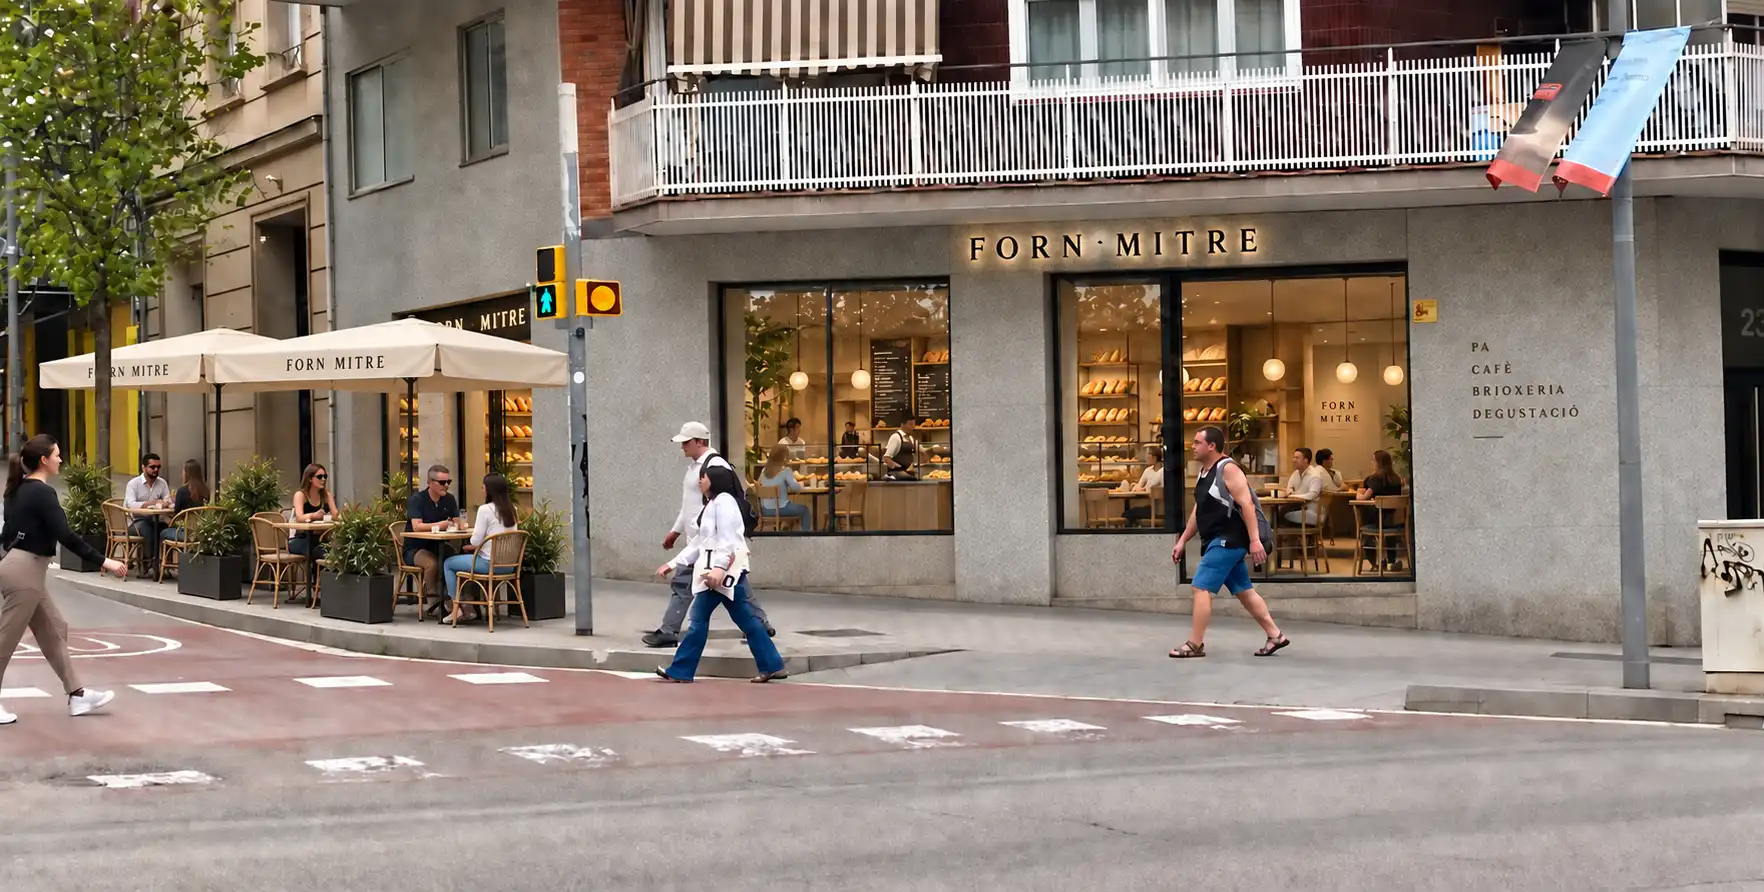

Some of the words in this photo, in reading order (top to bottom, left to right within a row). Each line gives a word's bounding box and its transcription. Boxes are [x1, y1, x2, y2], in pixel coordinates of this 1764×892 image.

[969, 234, 1082, 261] FORN
[1116, 228, 1258, 257] MITRE
[1471, 342, 1490, 352] PA
[286, 358, 325, 372] FORN
[335, 355, 385, 370] MITRE
[1471, 361, 1512, 375] CAFÈ
[88, 366, 125, 378] FRN
[132, 364, 169, 377] MITRE
[1472, 385, 1564, 396] BRIOXERIA
[1321, 401, 1355, 410] FORN
[1320, 415, 1359, 423] MITRE
